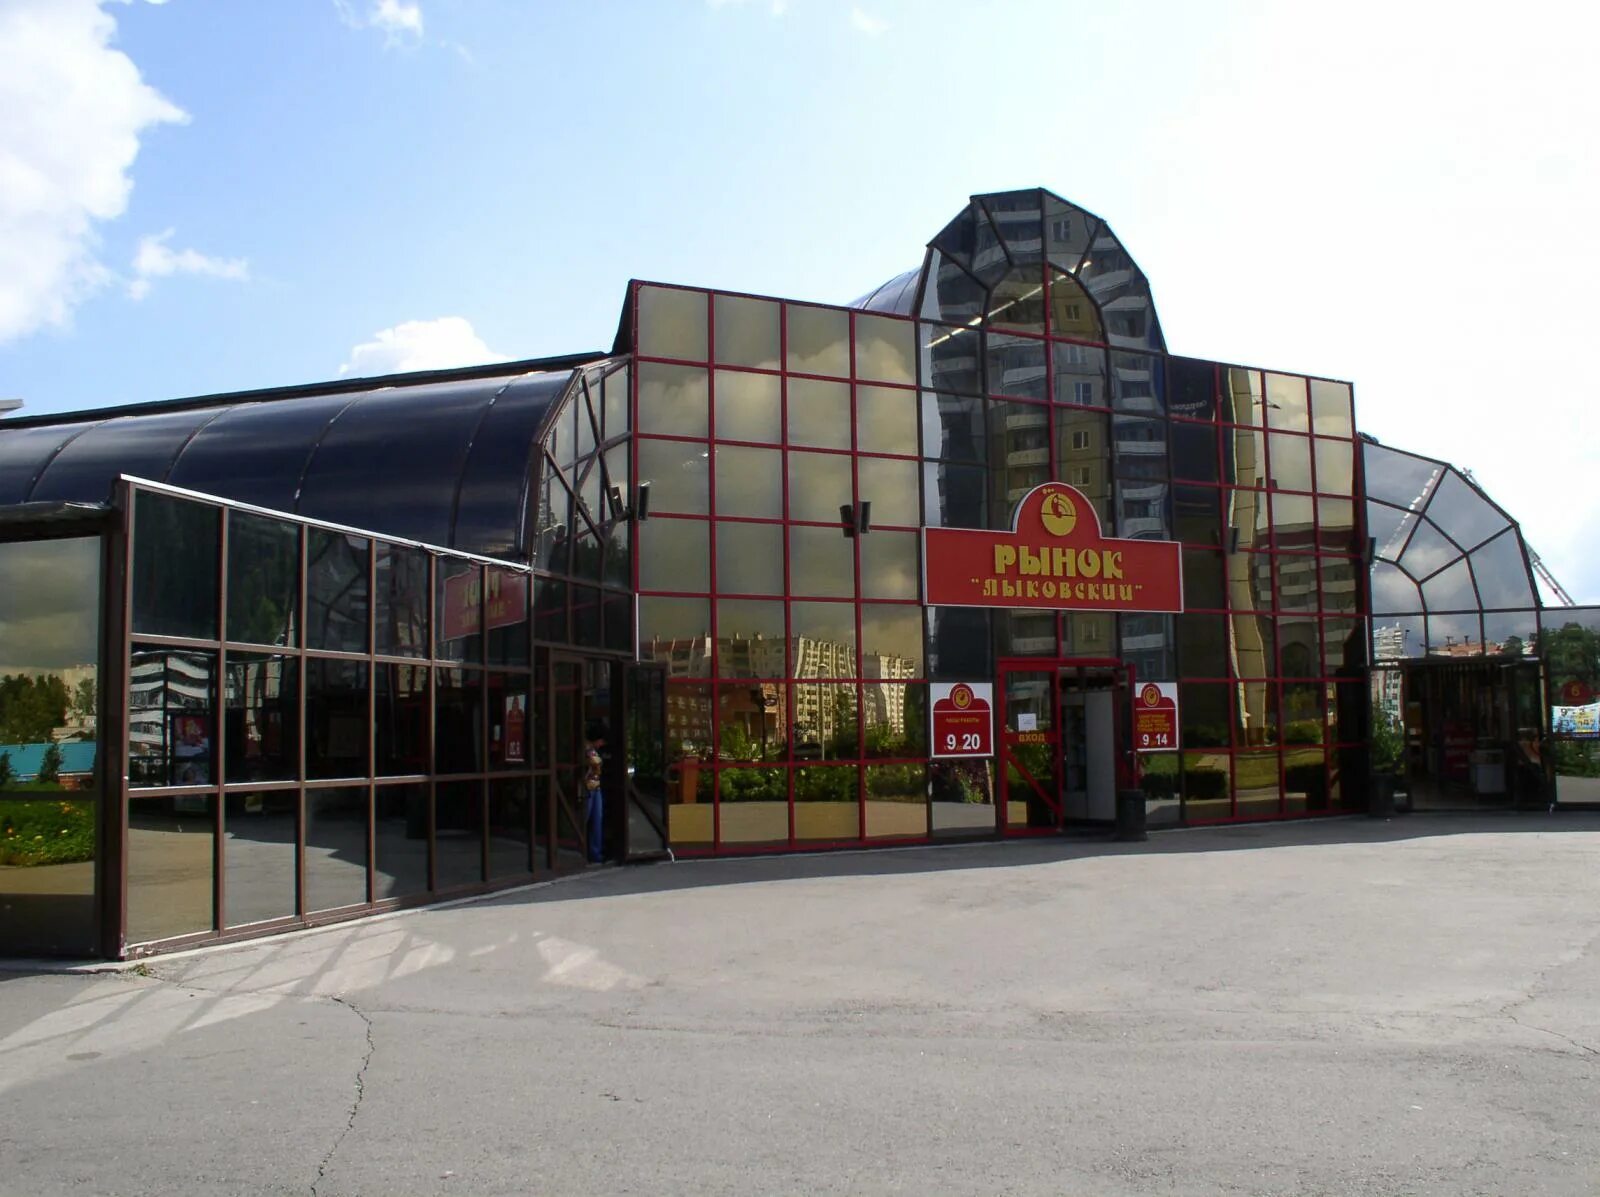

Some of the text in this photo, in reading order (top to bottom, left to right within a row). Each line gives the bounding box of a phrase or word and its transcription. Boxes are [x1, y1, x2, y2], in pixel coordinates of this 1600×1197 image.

[994, 544, 1123, 579] РЫНОК
[947, 733, 957, 750] 9
[962, 733, 980, 750] 20
[1018, 733, 1046, 744] ВХОД
[1142, 733, 1149, 746] 9
[1155, 733, 1168, 745] 14
